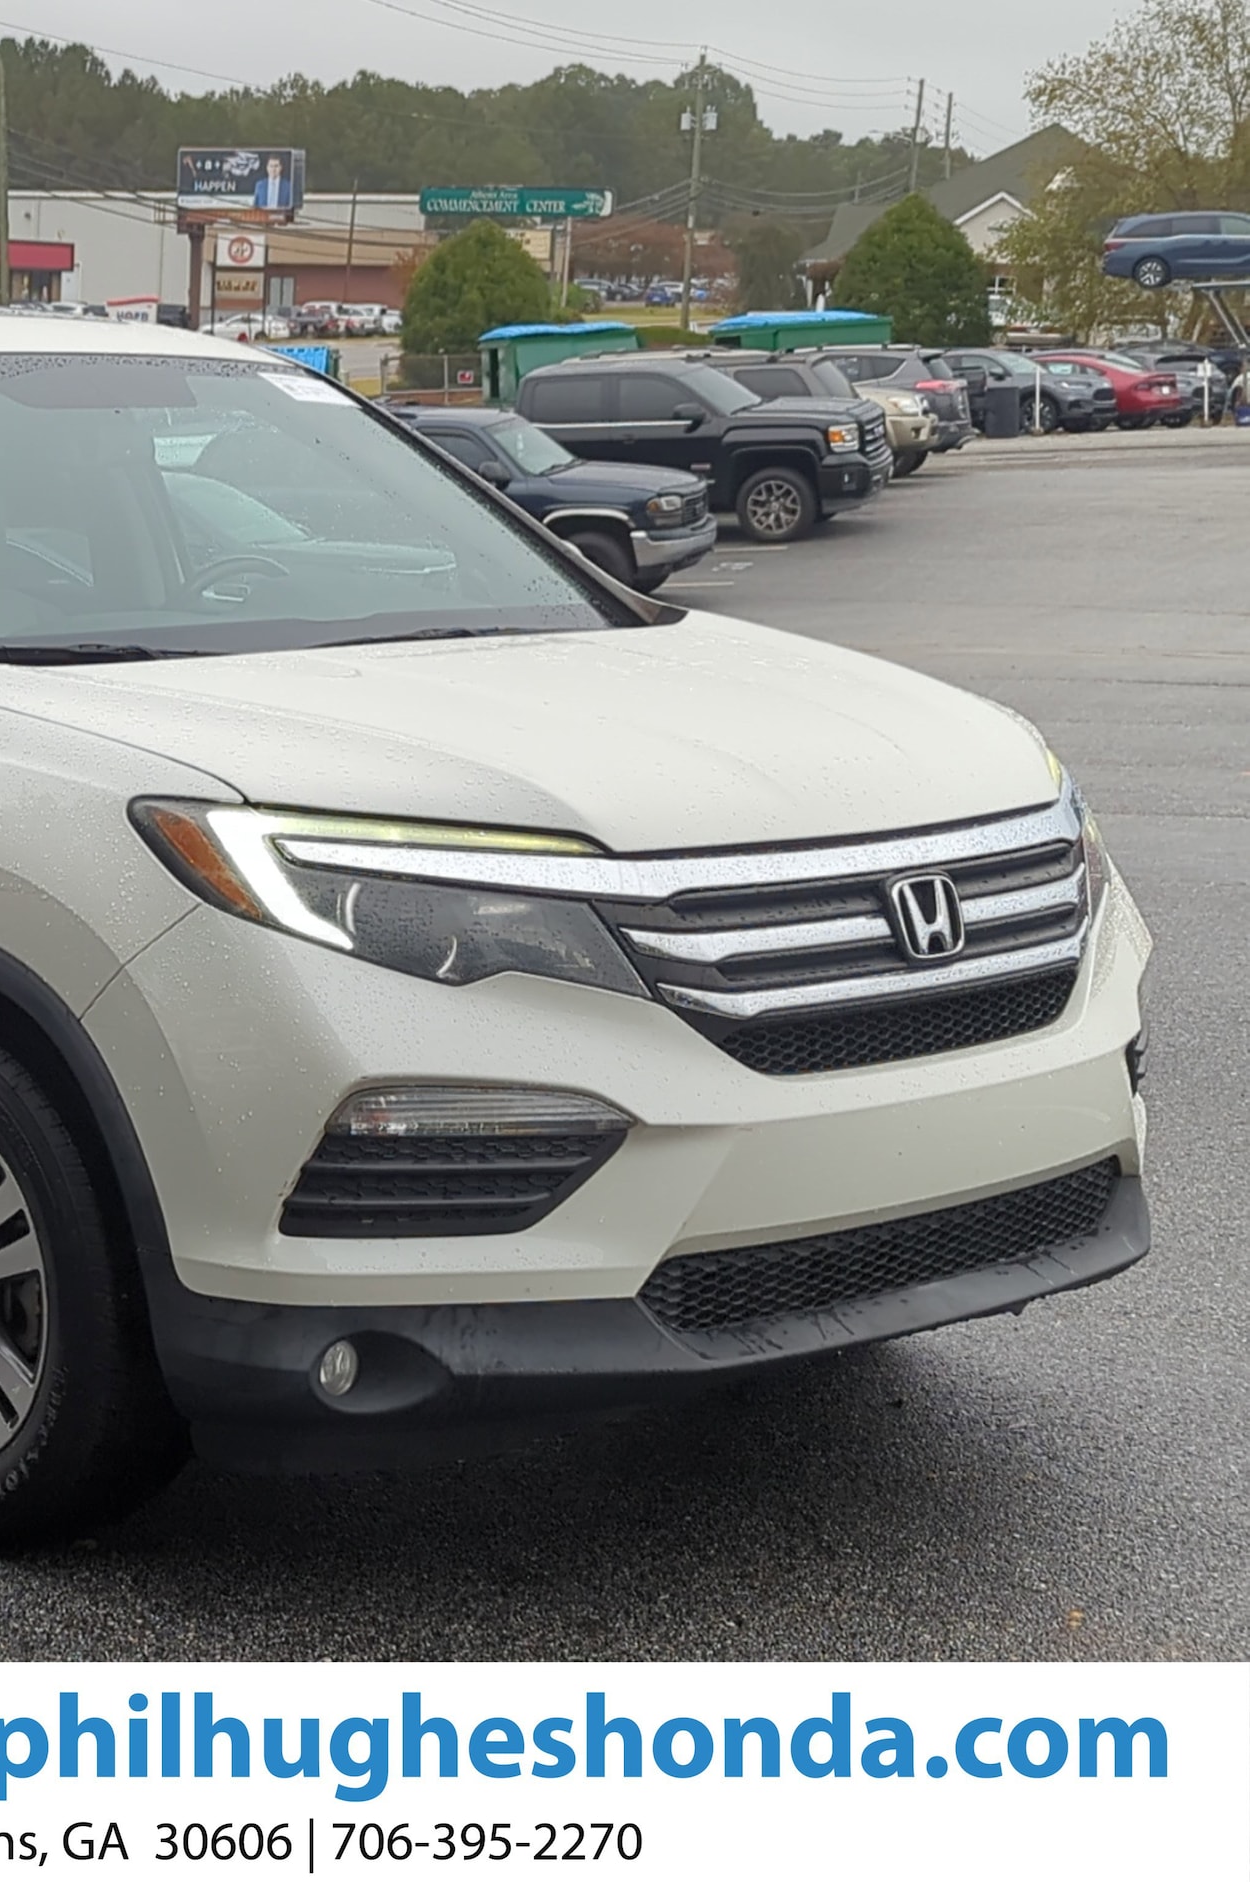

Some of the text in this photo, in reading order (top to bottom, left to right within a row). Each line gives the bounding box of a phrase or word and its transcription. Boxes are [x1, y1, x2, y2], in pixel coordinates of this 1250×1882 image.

[193, 179, 237, 192] HAPPEN
[499, 191, 518, 199] Area
[426, 198, 566, 213] COMMENCEMENT CENTER
